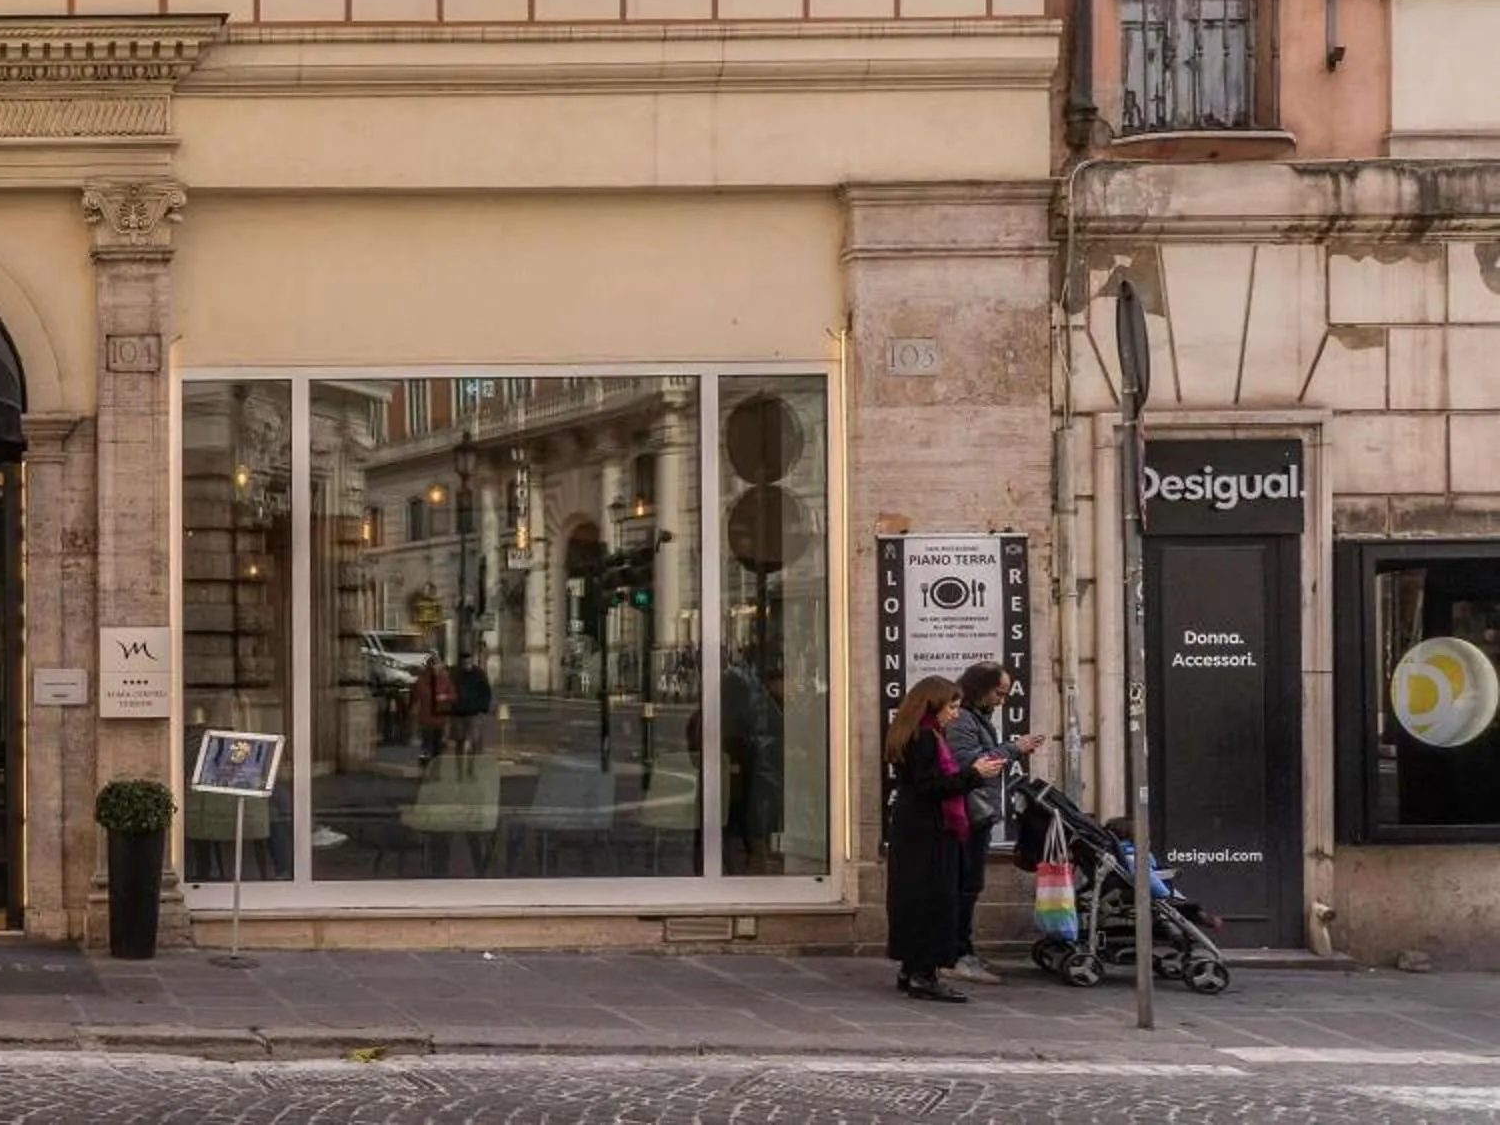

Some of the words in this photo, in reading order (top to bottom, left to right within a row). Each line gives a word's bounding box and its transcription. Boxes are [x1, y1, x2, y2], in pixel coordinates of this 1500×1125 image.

[909, 554, 951, 566] PIANO
[954, 554, 997, 565] TERRA
[1184, 630, 1245, 645] Donna.
[1171, 651, 1257, 667] Accessori.
[1167, 848, 1263, 864] desigual.com
